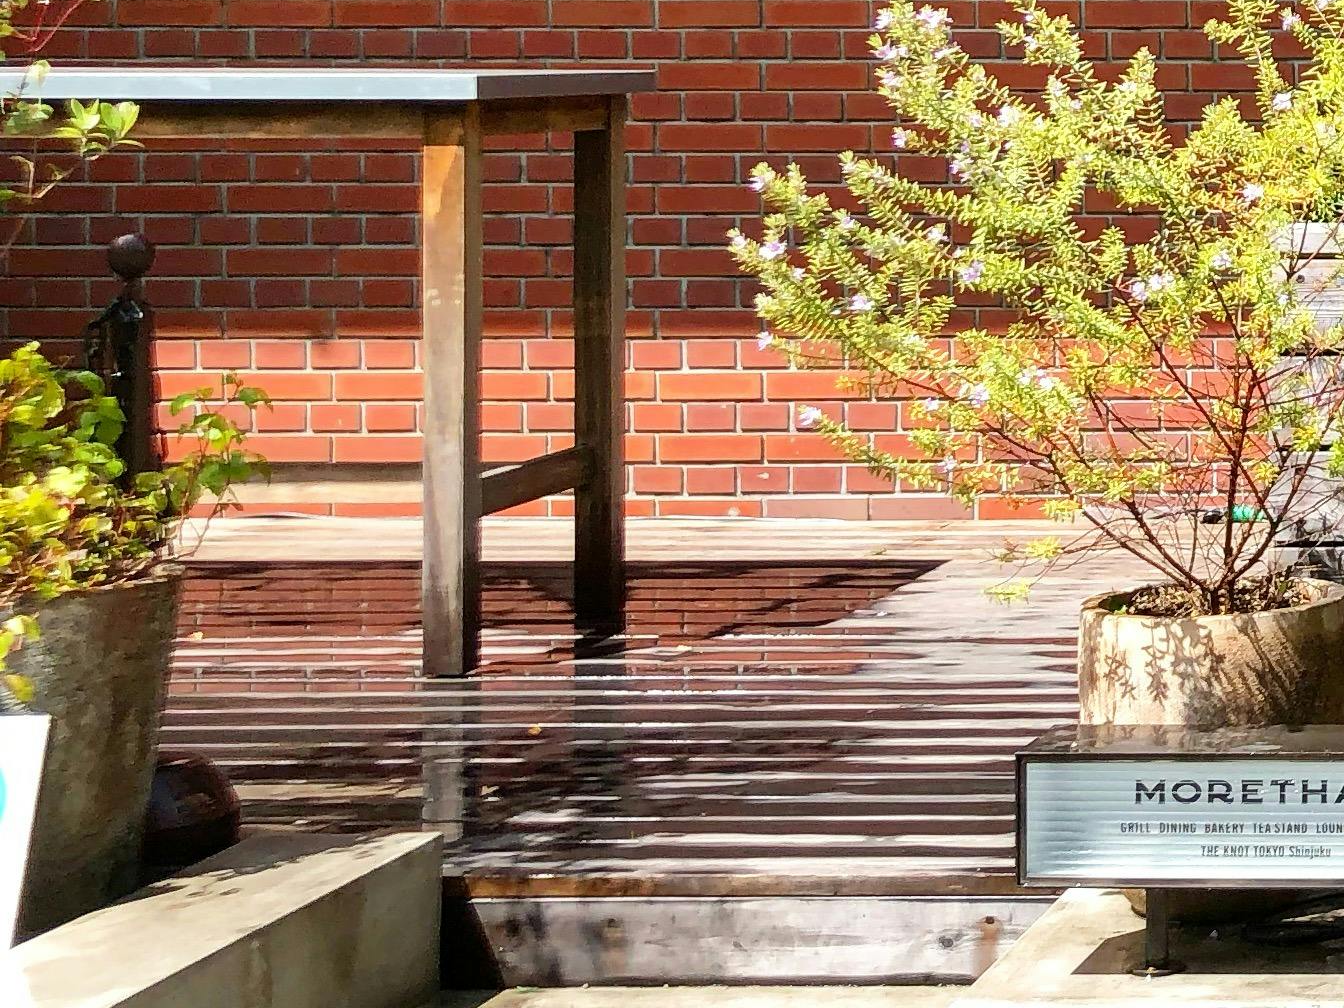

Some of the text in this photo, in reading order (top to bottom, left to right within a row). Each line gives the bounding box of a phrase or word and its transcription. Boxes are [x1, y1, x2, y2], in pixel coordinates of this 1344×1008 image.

[1120, 822, 1151, 833] GRILL
[1159, 822, 1197, 833] DINING
[1205, 823, 1244, 833] BAKERY
[1201, 845, 1331, 859] THE KNOT TOKYO Shinjuku
